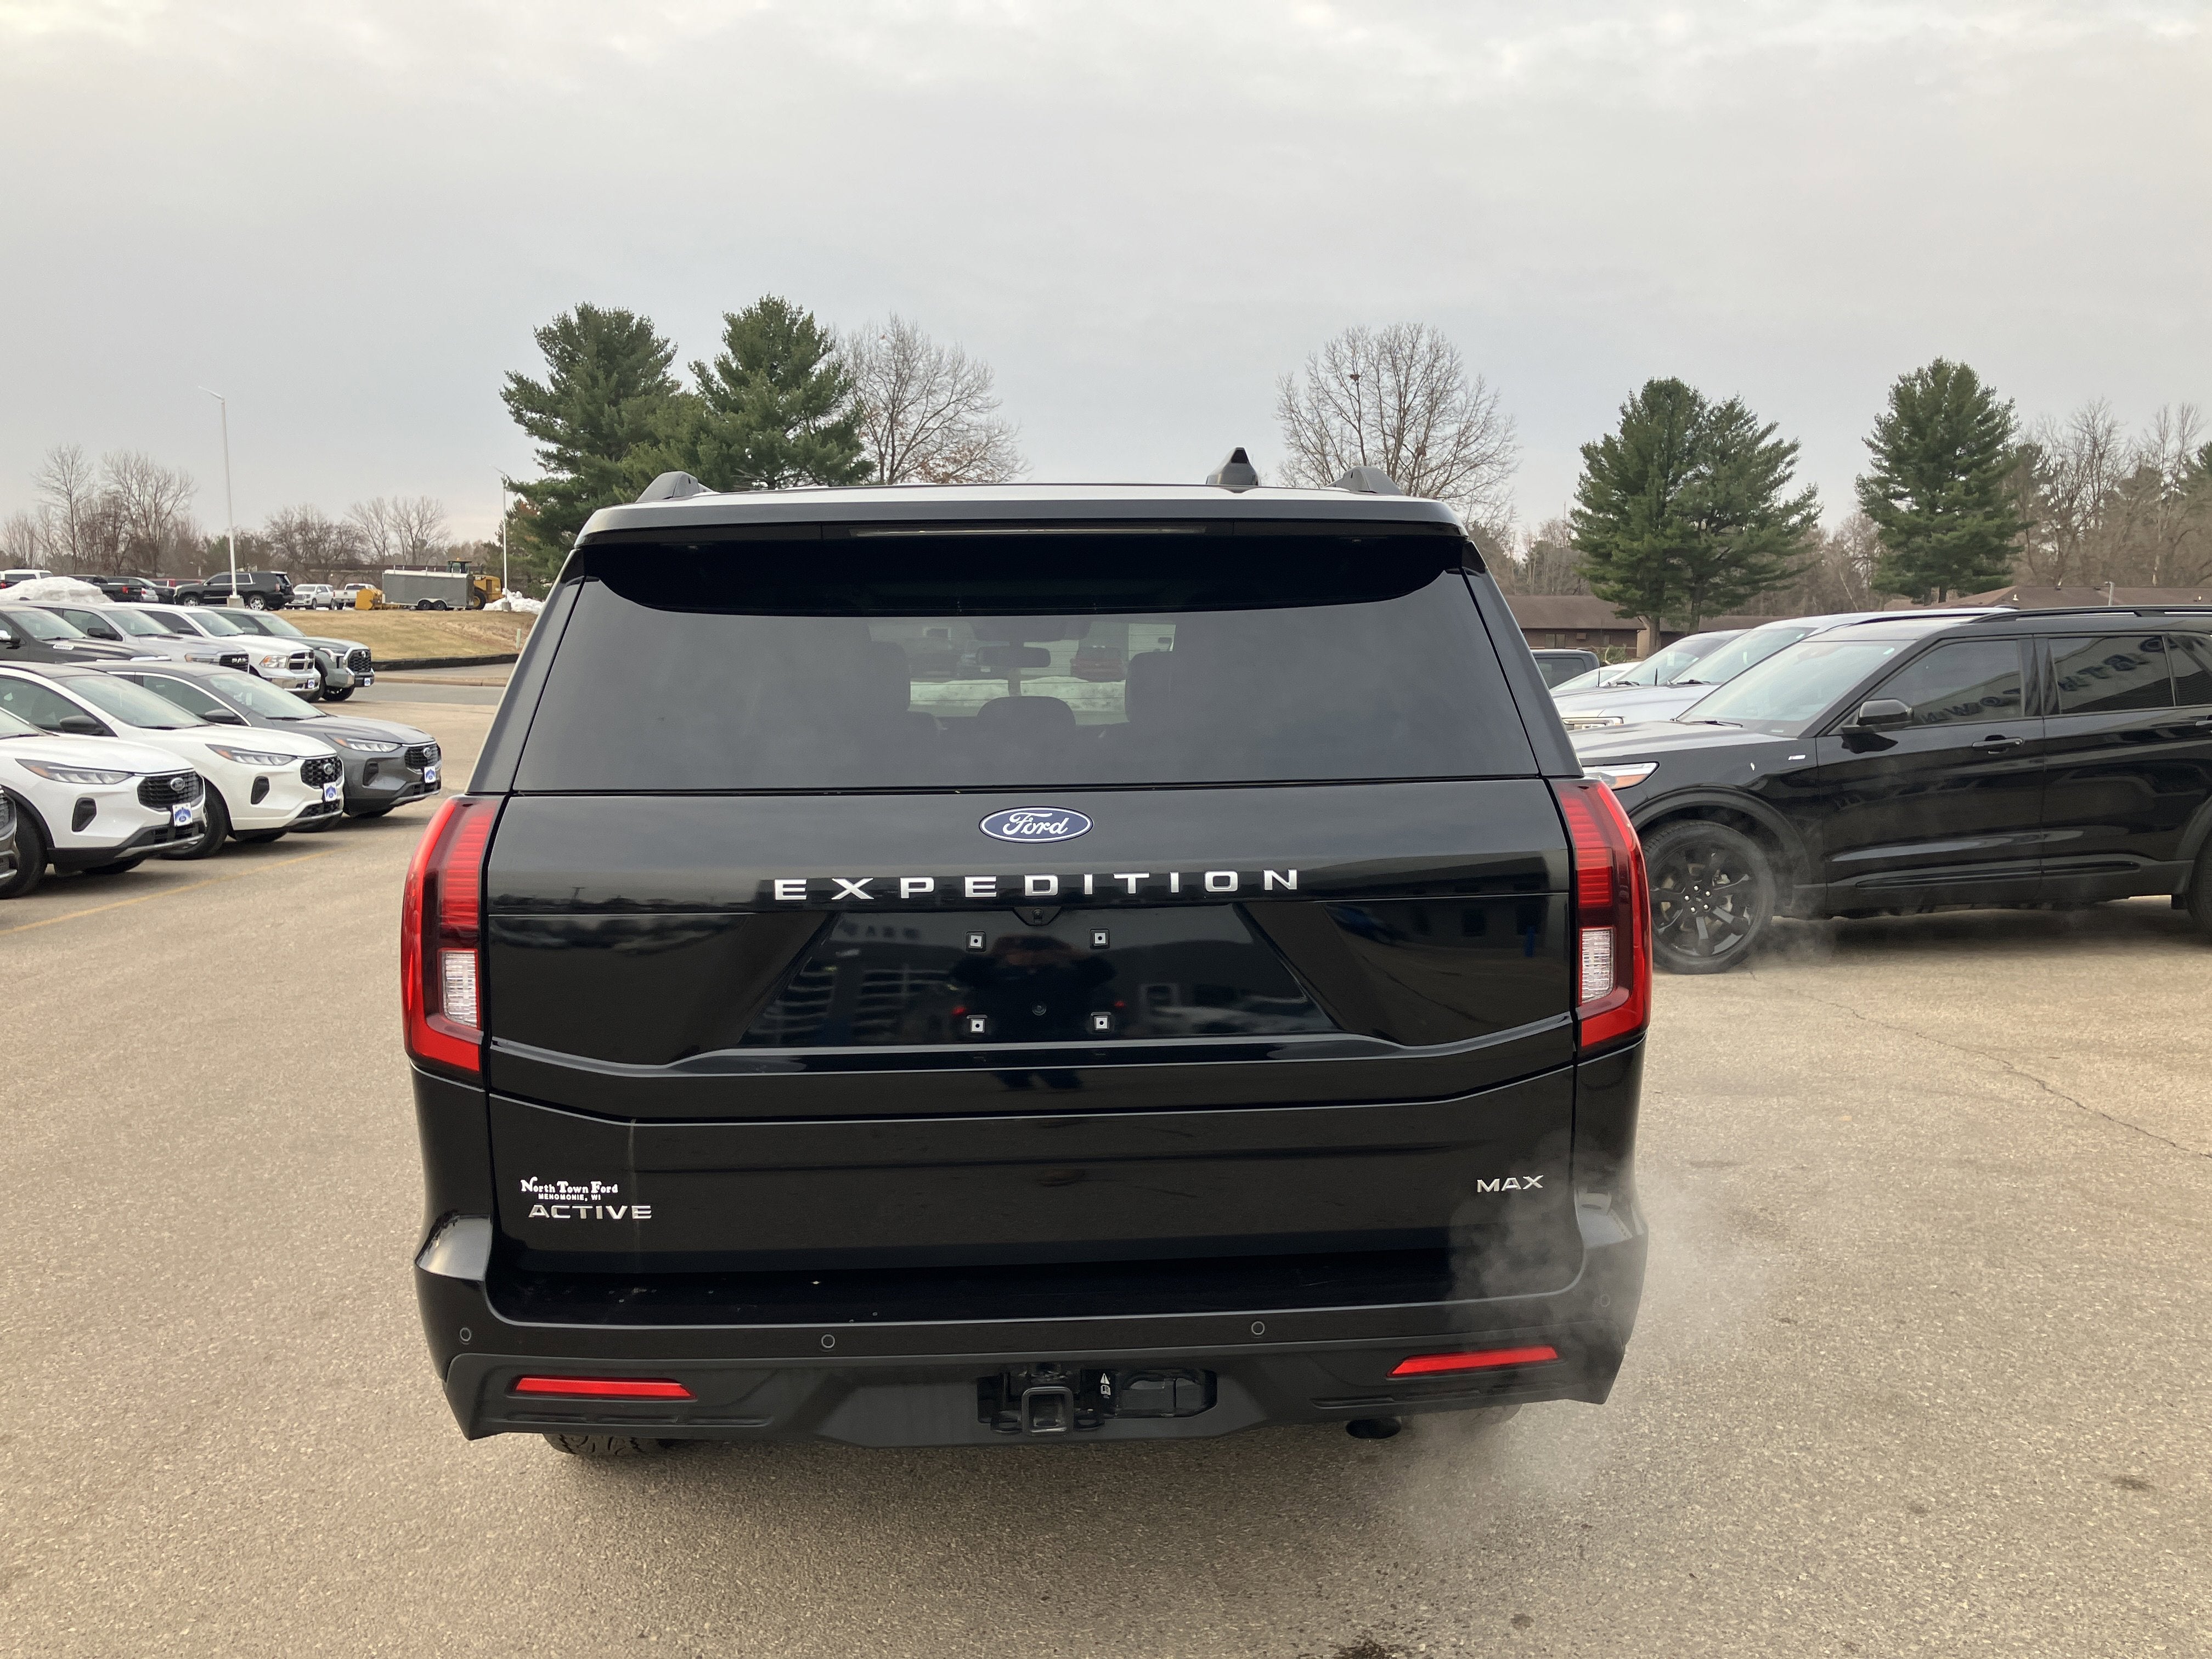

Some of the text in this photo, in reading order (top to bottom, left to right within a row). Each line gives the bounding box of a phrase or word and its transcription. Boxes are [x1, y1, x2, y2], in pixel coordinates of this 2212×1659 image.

[1002, 812, 1069, 835] Ford
[774, 869, 1298, 901] EXPEDITION
[521, 1176, 618, 1193] North Town Ford
[1476, 1175, 1544, 1193] MAX
[528, 1204, 652, 1220] ACTIVE
